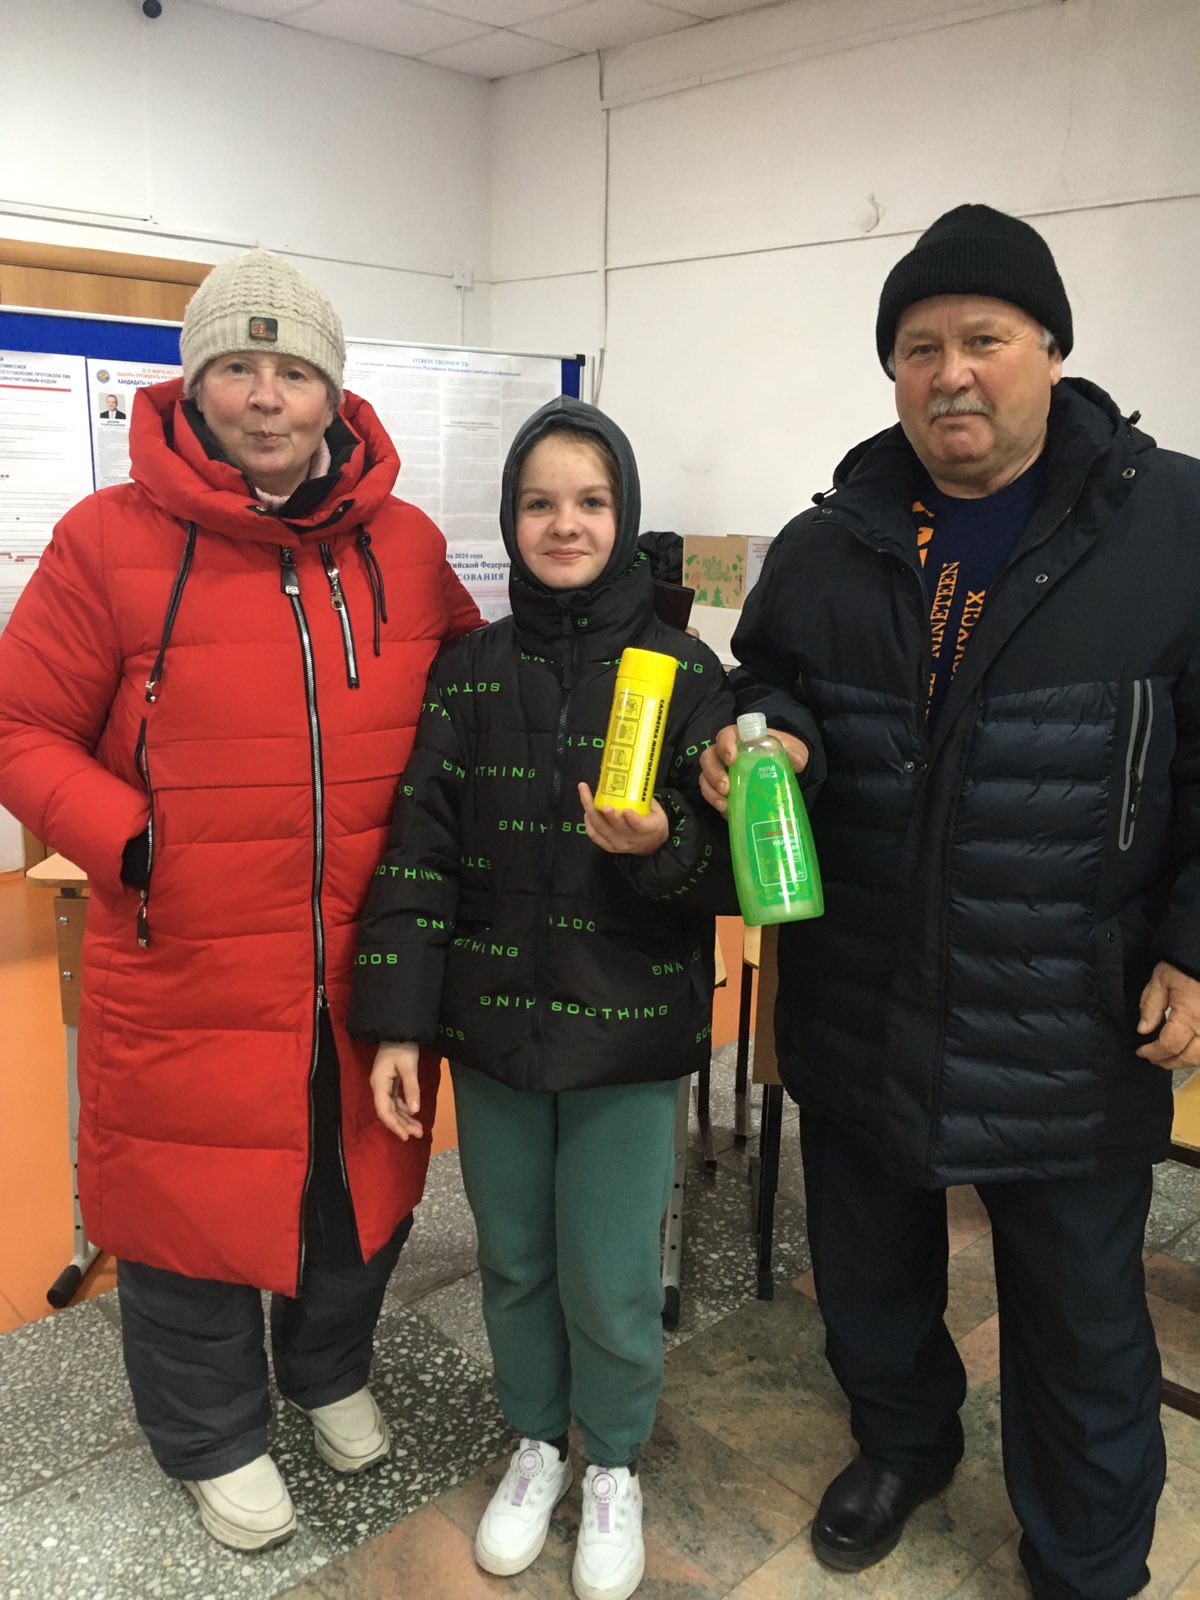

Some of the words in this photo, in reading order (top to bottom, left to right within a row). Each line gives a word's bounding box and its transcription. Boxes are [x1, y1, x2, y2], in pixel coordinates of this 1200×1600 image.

[653, 699, 665, 740] САЛФЕТКА
[641, 740, 657, 802] МНОГОРАЗОВАЯ
[551, 1001, 669, 1020] SOOTHING
